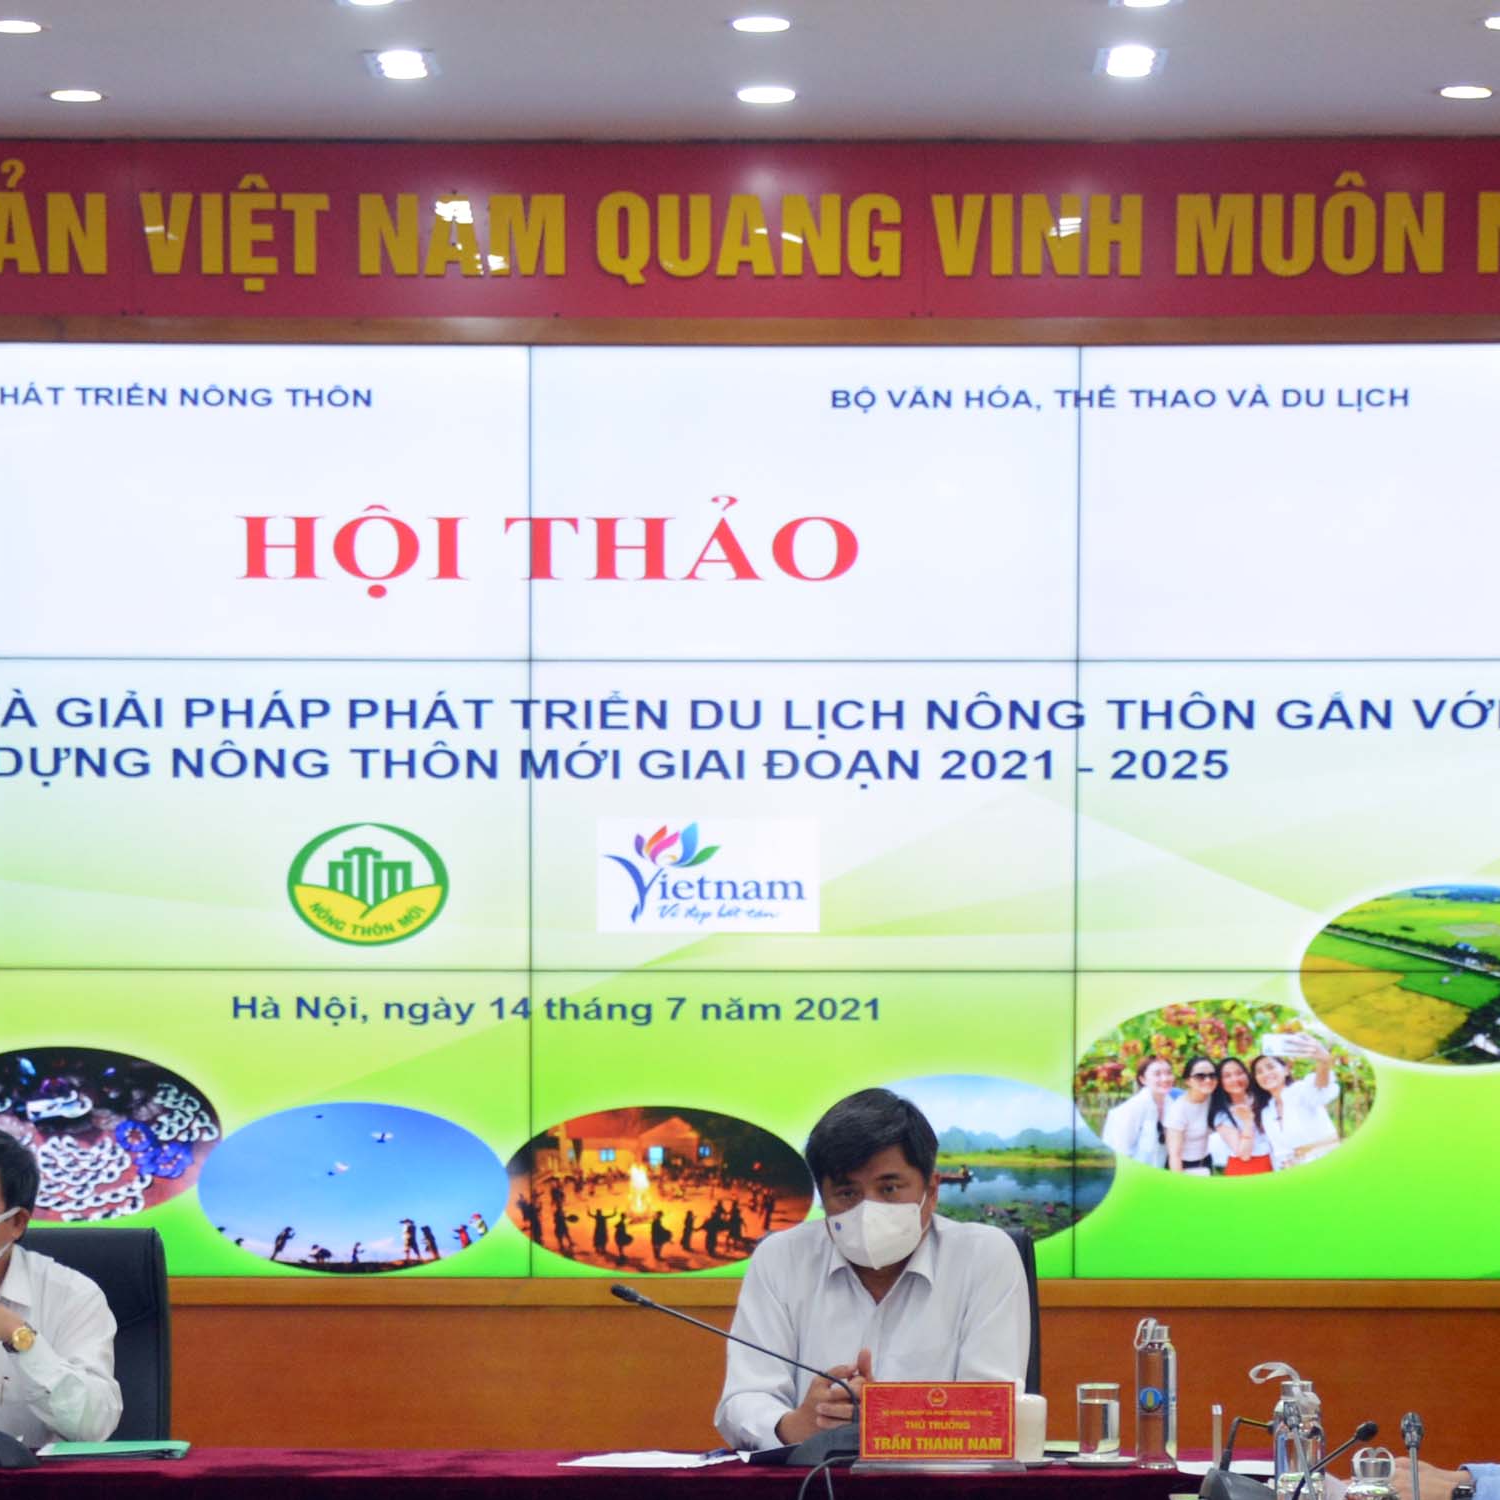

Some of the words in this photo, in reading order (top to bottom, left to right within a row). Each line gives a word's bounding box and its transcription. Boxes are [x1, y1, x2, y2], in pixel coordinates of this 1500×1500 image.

[141, 174, 329, 292] VIỆT
[359, 194, 567, 279] NAM
[596, 191, 902, 285] QUANG
[932, 193, 1143, 277] VINH
[1176, 172, 1445, 277] MUÔN
[180, 385, 273, 408] NÔNG
[286, 385, 373, 408] THÔN
[831, 387, 877, 413] BỘ
[887, 386, 953, 409] VĂN
[965, 386, 1042, 411] HÓA,
[1129, 389, 1217, 408] THAO
[1227, 385, 1270, 408] VÀ
[1282, 388, 1325, 408] DU
[1337, 388, 1410, 412] LỊCH
[238, 504, 471, 599] HỘI
[504, 496, 860, 583] THẢO
[55, 690, 164, 729] GIẢI
[184, 689, 331, 729] PHÁP
[348, 690, 494, 730] PHÁT
[510, 690, 668, 731] TRIỂN
[690, 699, 762, 731] DU
[785, 699, 904, 740] LỊCH
[926, 691, 1087, 731] NÔNG
[1106, 691, 1256, 731] THÔN
[1276, 691, 1394, 731] GẮN
[171, 739, 330, 780] NÔNG
[349, 740, 498, 780] THÔN
[519, 740, 621, 780] MỚI
[638, 749, 746, 780] GIAI
[762, 749, 920, 790] ĐOẠN
[940, 749, 1054, 780] 2021
[1110, 749, 1230, 780] 2025
[603, 853, 806, 923] Vietnam
[351, 921, 396, 937] THÔN
[232, 996, 281, 1020] Hà
[296, 996, 368, 1026] Nội,
[383, 997, 476, 1025] ngày
[490, 996, 532, 1020] 14
[544, 996, 653, 1026] tháng
[667, 997, 687, 1020] 7
[701, 997, 782, 1021] năm
[795, 997, 880, 1020] 2021
[916, 1437, 964, 1450] THANH
[968, 1437, 1002, 1450] NAM
